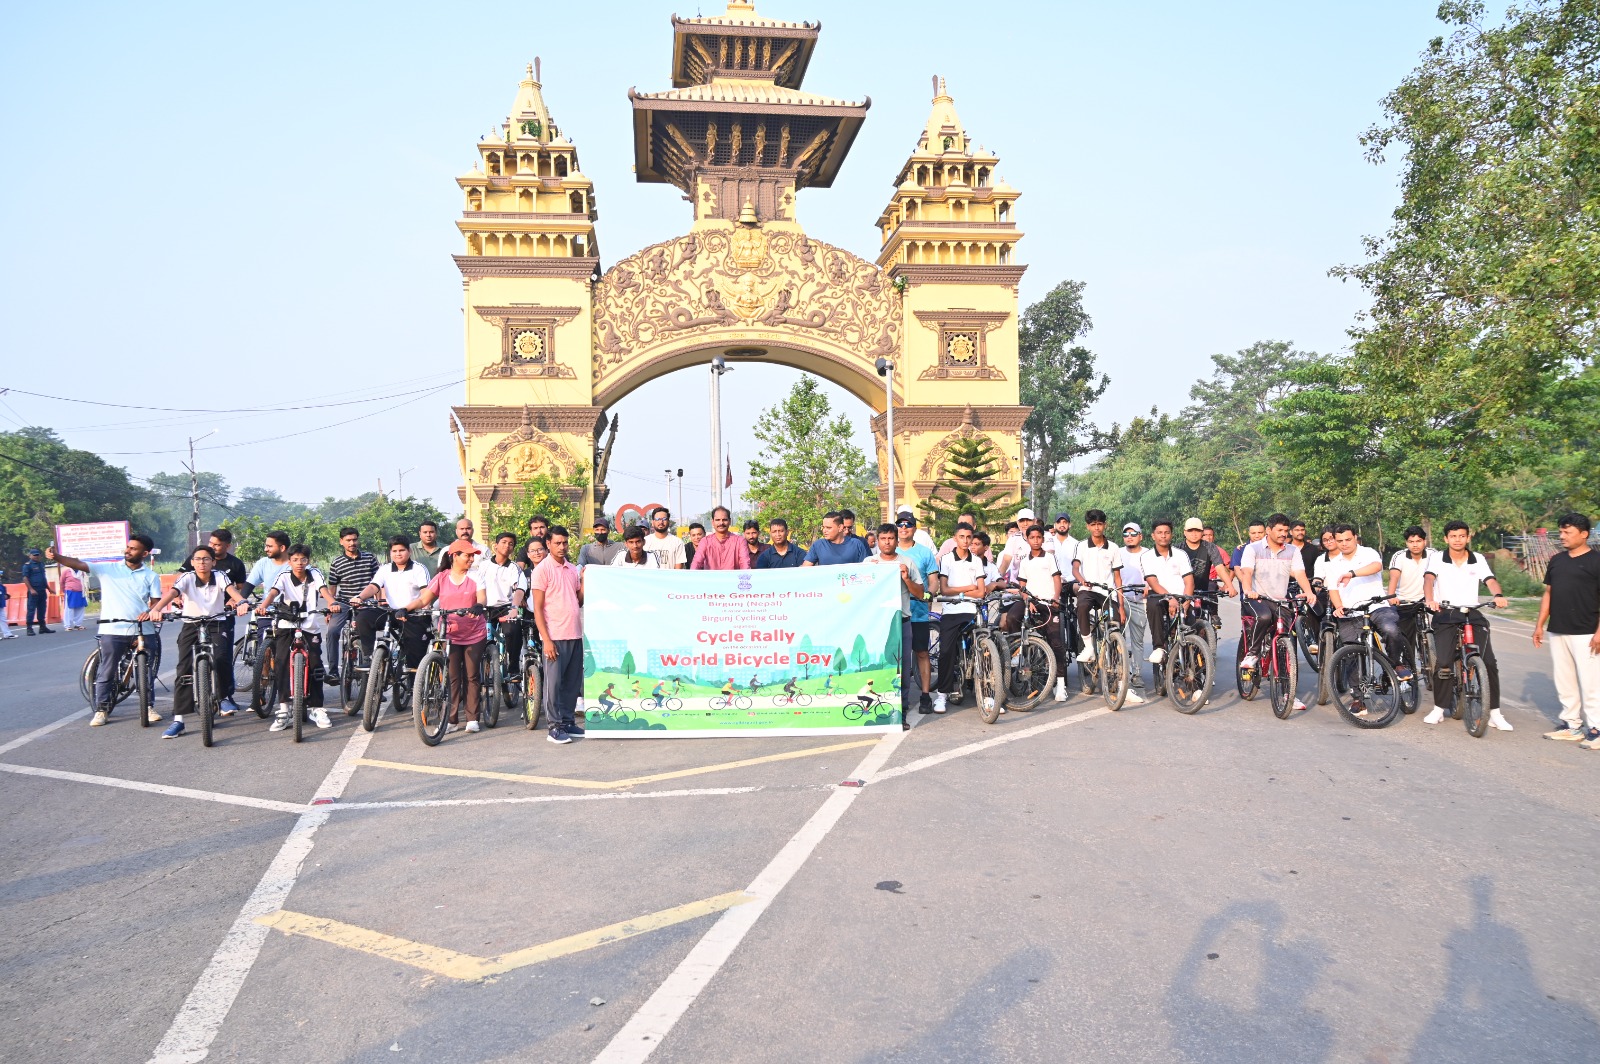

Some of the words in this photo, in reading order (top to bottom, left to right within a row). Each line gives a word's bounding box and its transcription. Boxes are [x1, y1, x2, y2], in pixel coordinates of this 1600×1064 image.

[667, 592, 726, 600] Consulate
[729, 591, 775, 599] General
[778, 591, 791, 599] of
[708, 600, 743, 608] Birgunj
[746, 600, 783, 608] (Nepal)
[701, 614, 733, 623] Birgunj
[735, 614, 766, 623] Cycling
[768, 613, 788, 621] Club
[697, 630, 745, 645] Cycle
[750, 629, 795, 644] Rally
[660, 652, 718, 667] World
[725, 652, 790, 668] Bicycle
[796, 652, 832, 667] Day
